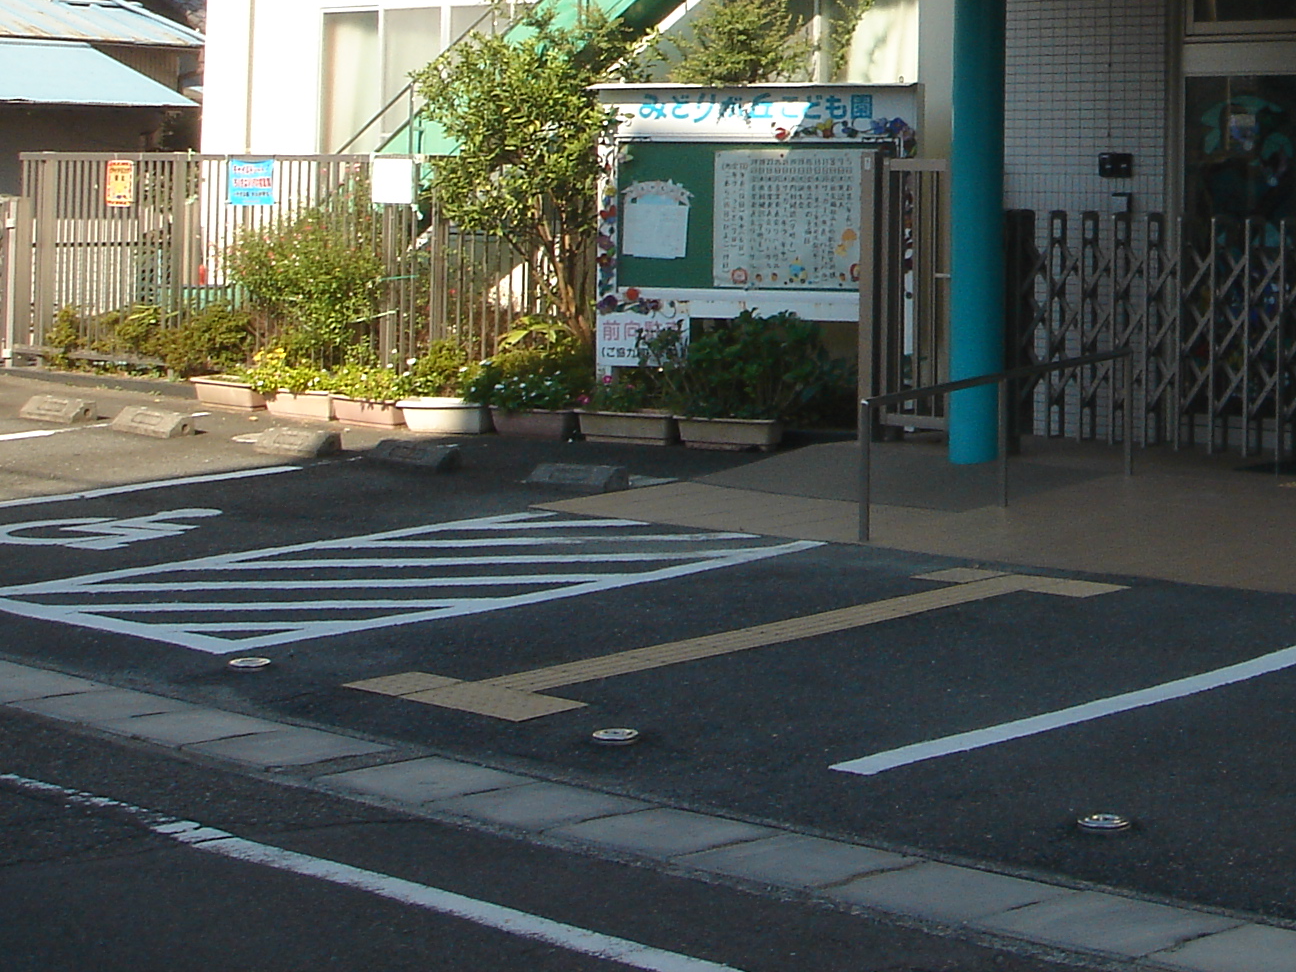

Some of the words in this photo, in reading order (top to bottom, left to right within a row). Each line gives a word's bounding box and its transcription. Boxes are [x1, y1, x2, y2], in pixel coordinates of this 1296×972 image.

[639, 93, 873, 123] みどりが丘こども園
